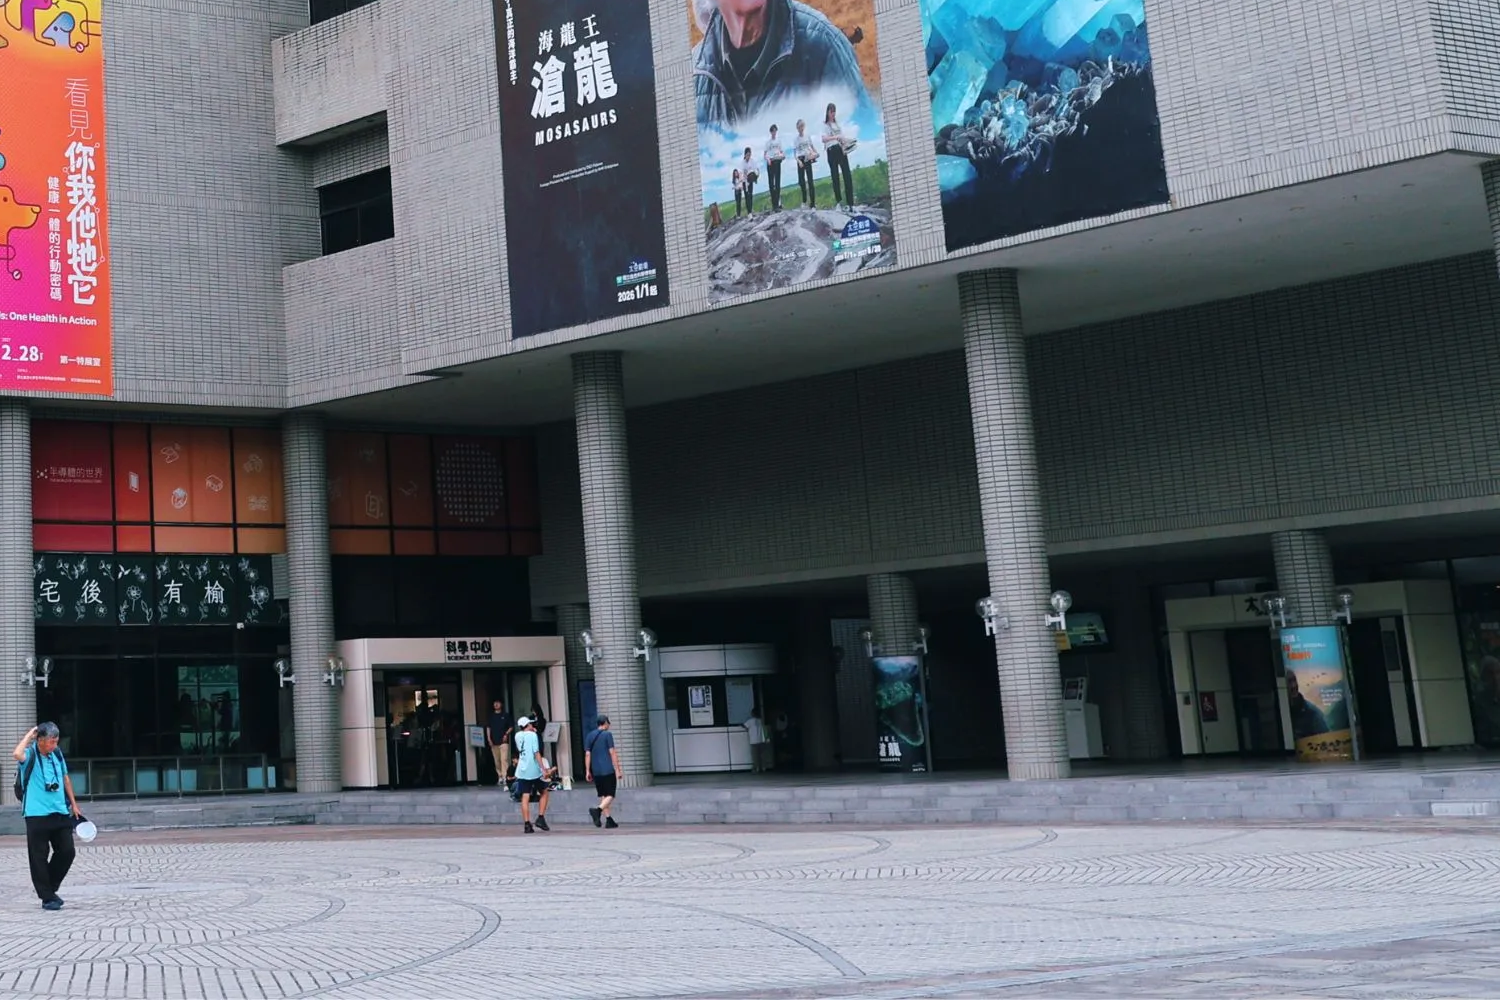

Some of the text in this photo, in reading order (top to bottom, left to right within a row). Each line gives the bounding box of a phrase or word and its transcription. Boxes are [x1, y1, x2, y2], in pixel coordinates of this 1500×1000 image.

[538, 13, 601, 56] 海龍王
[530, 40, 618, 119] 滄龍
[534, 108, 618, 147] MOSASAURS
[9, 313, 28, 321] One
[29, 314, 58, 323] Health
[69, 316, 97, 326] Action
[60, 355, 101, 367] 第一特展室
[446, 640, 492, 655] 科學中心
